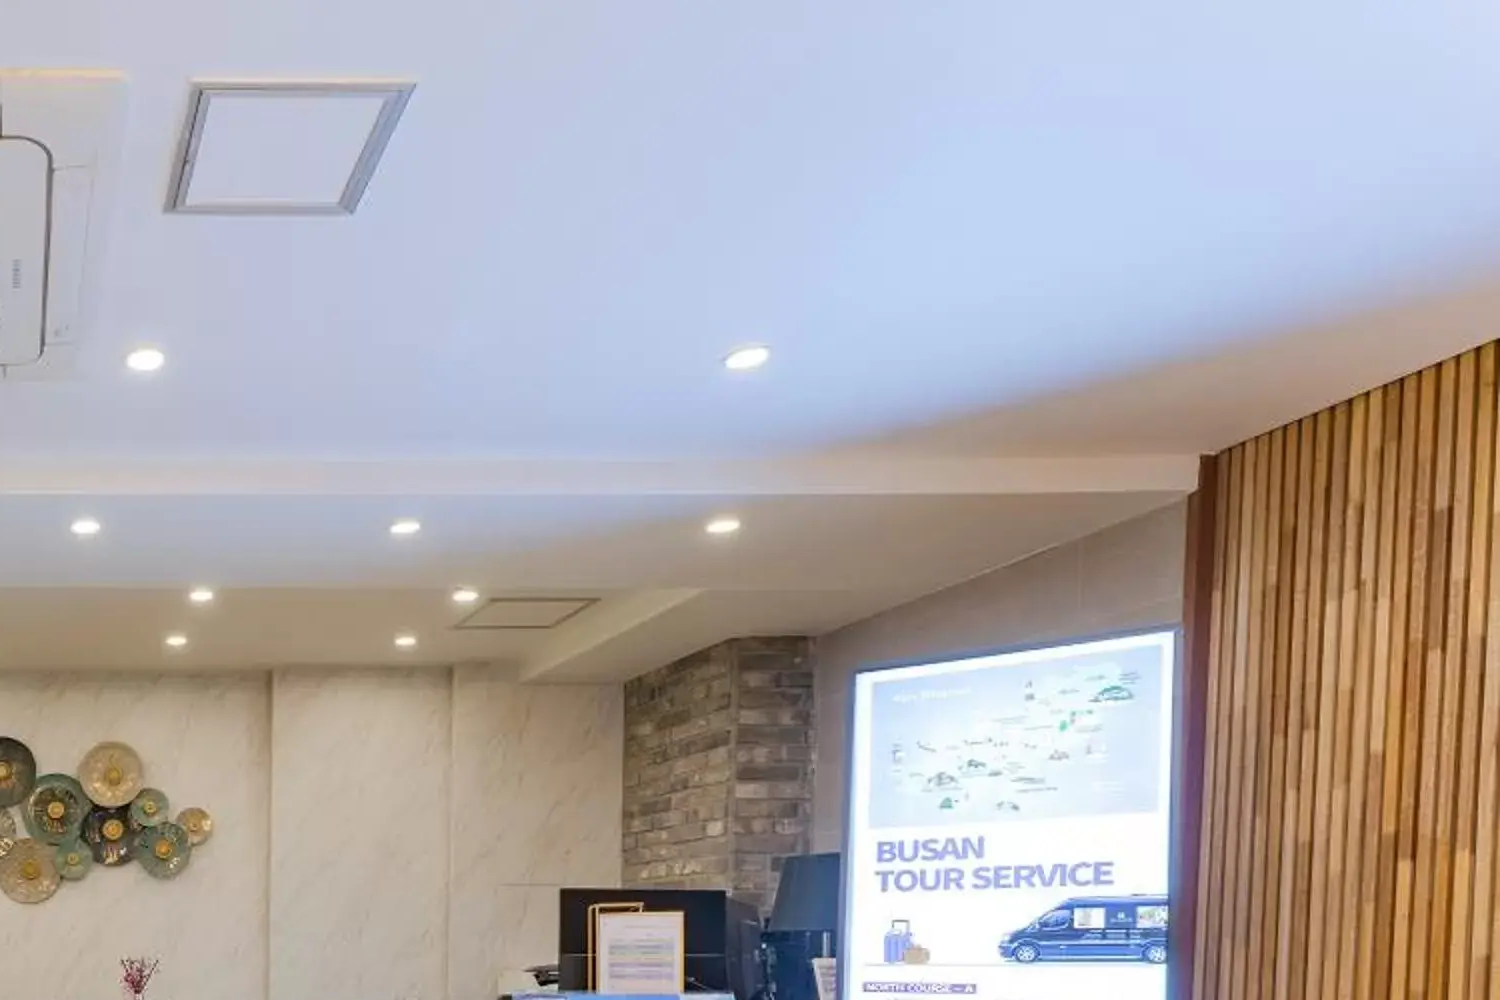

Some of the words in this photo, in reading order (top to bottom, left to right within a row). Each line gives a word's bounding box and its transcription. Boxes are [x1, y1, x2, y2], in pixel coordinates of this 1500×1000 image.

[876, 836, 985, 863] BUSAN
[875, 868, 965, 893] TOUR
[972, 861, 1115, 890] SERVICE
